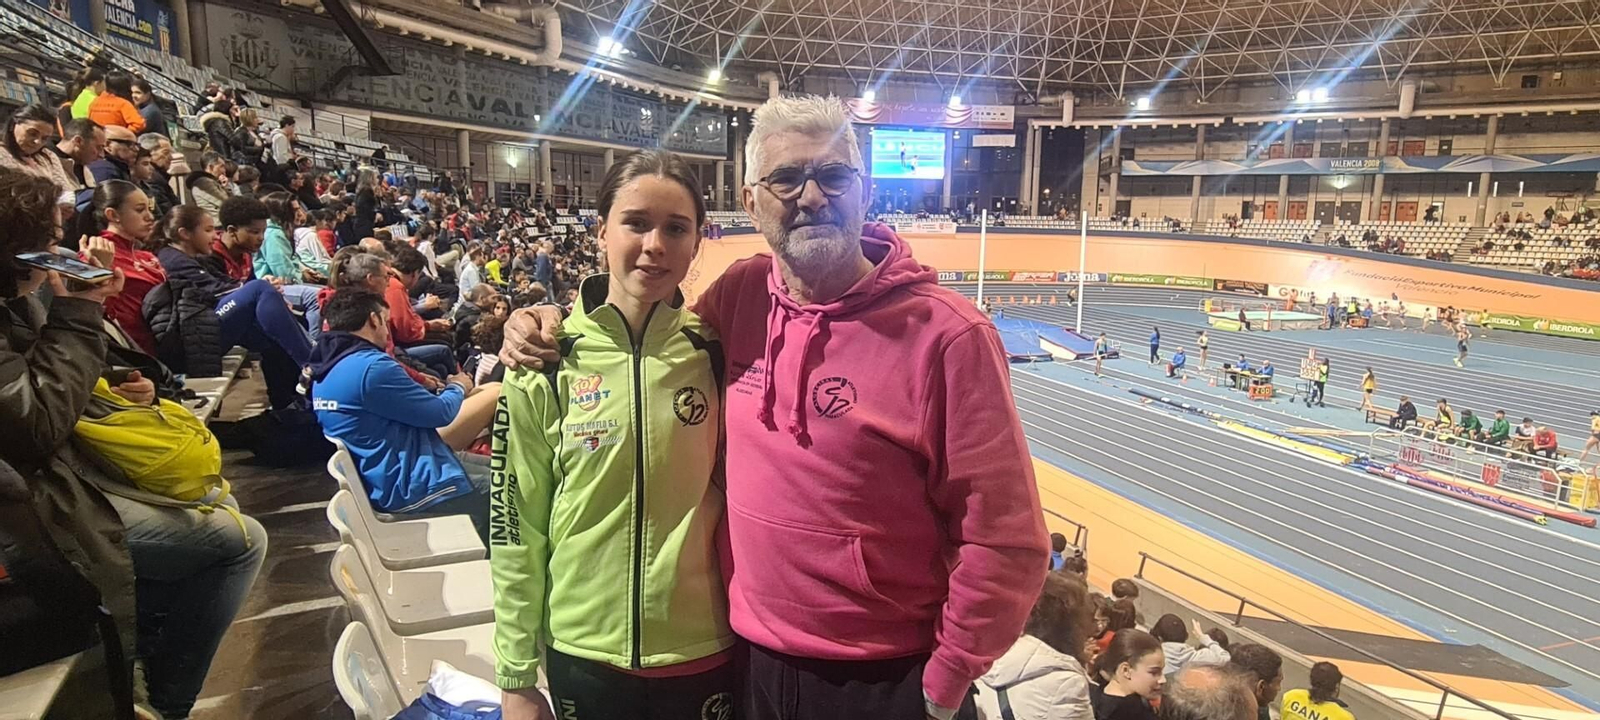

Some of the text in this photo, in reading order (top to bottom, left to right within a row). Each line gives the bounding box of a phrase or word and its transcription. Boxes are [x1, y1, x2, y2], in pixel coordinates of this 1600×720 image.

[1330, 160, 1363, 168] VALENCIA
[1549, 322, 1595, 336] IBERDROLA
[571, 374, 604, 397] TOY
[491, 395, 510, 546] INMACULADA
[506, 473, 521, 546] atletismo
